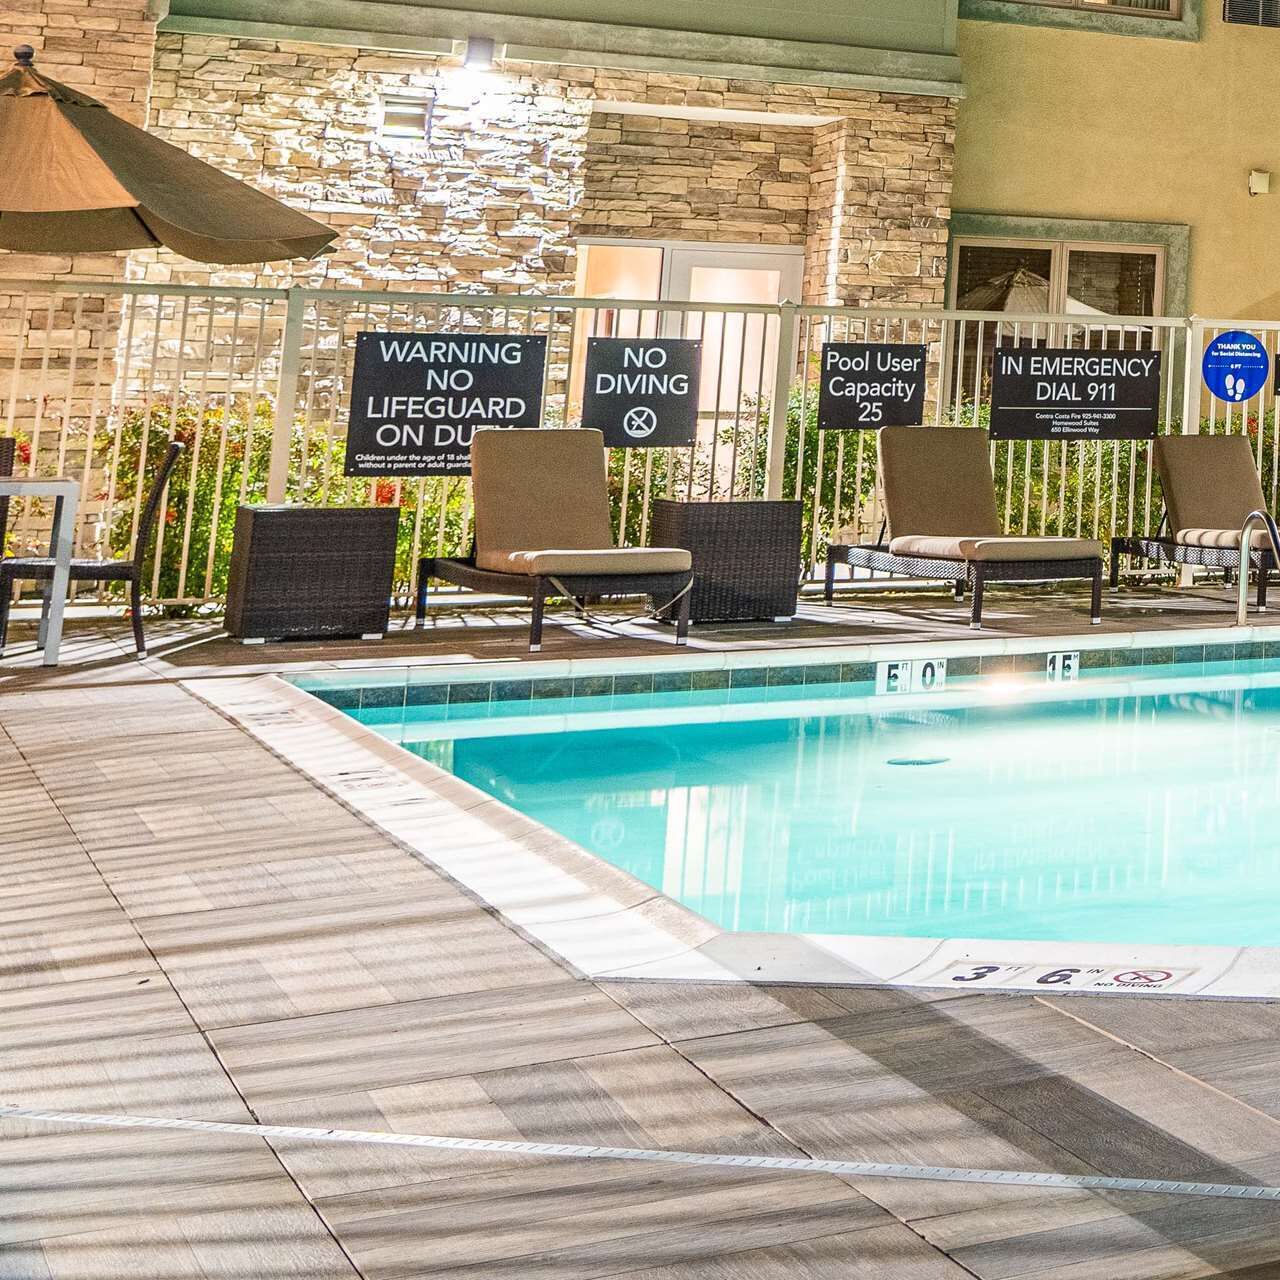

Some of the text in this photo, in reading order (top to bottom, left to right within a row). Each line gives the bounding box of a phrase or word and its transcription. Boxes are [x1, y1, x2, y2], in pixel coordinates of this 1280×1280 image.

[379, 340, 522, 365] WARNING
[623, 347, 667, 369] NO
[826, 350, 921, 372] Pool User
[1001, 356, 1154, 377] IN EMERGENCY
[425, 369, 474, 391] NO
[595, 373, 689, 395] DIVING
[828, 376, 916, 403] Capacity
[1036, 382, 1116, 401] DIAL 911
[366, 396, 527, 419] LIFEGUARD
[858, 401, 883, 422] 25
[375, 424, 515, 447] ON DU
[437, 453, 446, 461] of
[951, 966, 1001, 982] 3
[1036, 968, 1082, 984] 6
